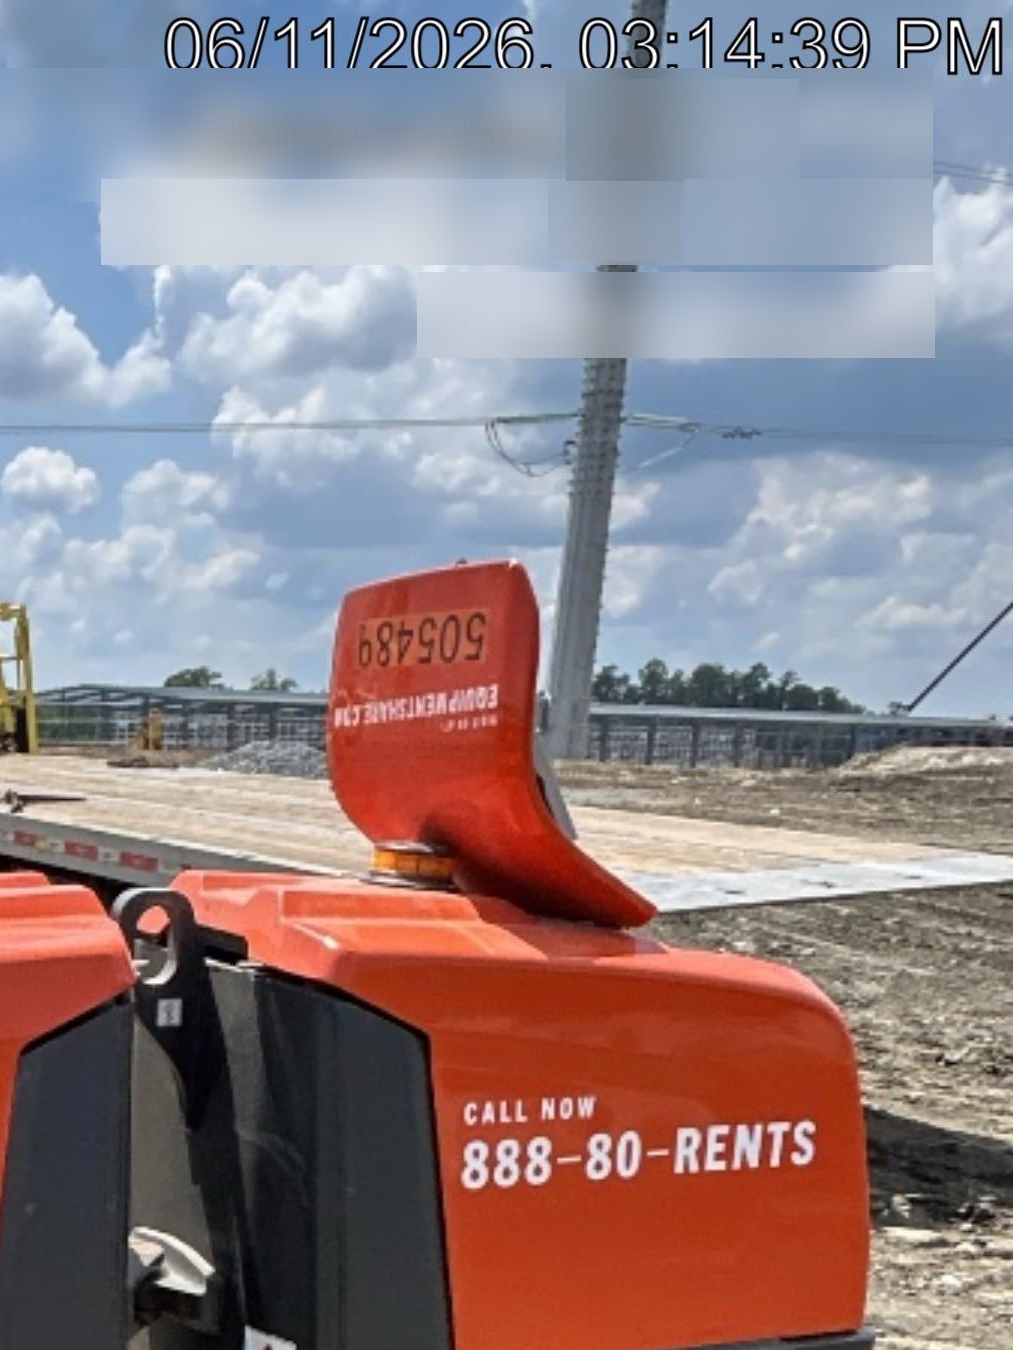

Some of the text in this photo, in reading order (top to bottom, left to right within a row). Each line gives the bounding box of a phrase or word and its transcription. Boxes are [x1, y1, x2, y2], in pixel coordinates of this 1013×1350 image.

[359, 612, 487, 668] 505489
[463, 1095, 597, 1126] CALL NOW
[461, 1120, 816, 1190] 888-80-RENTS
